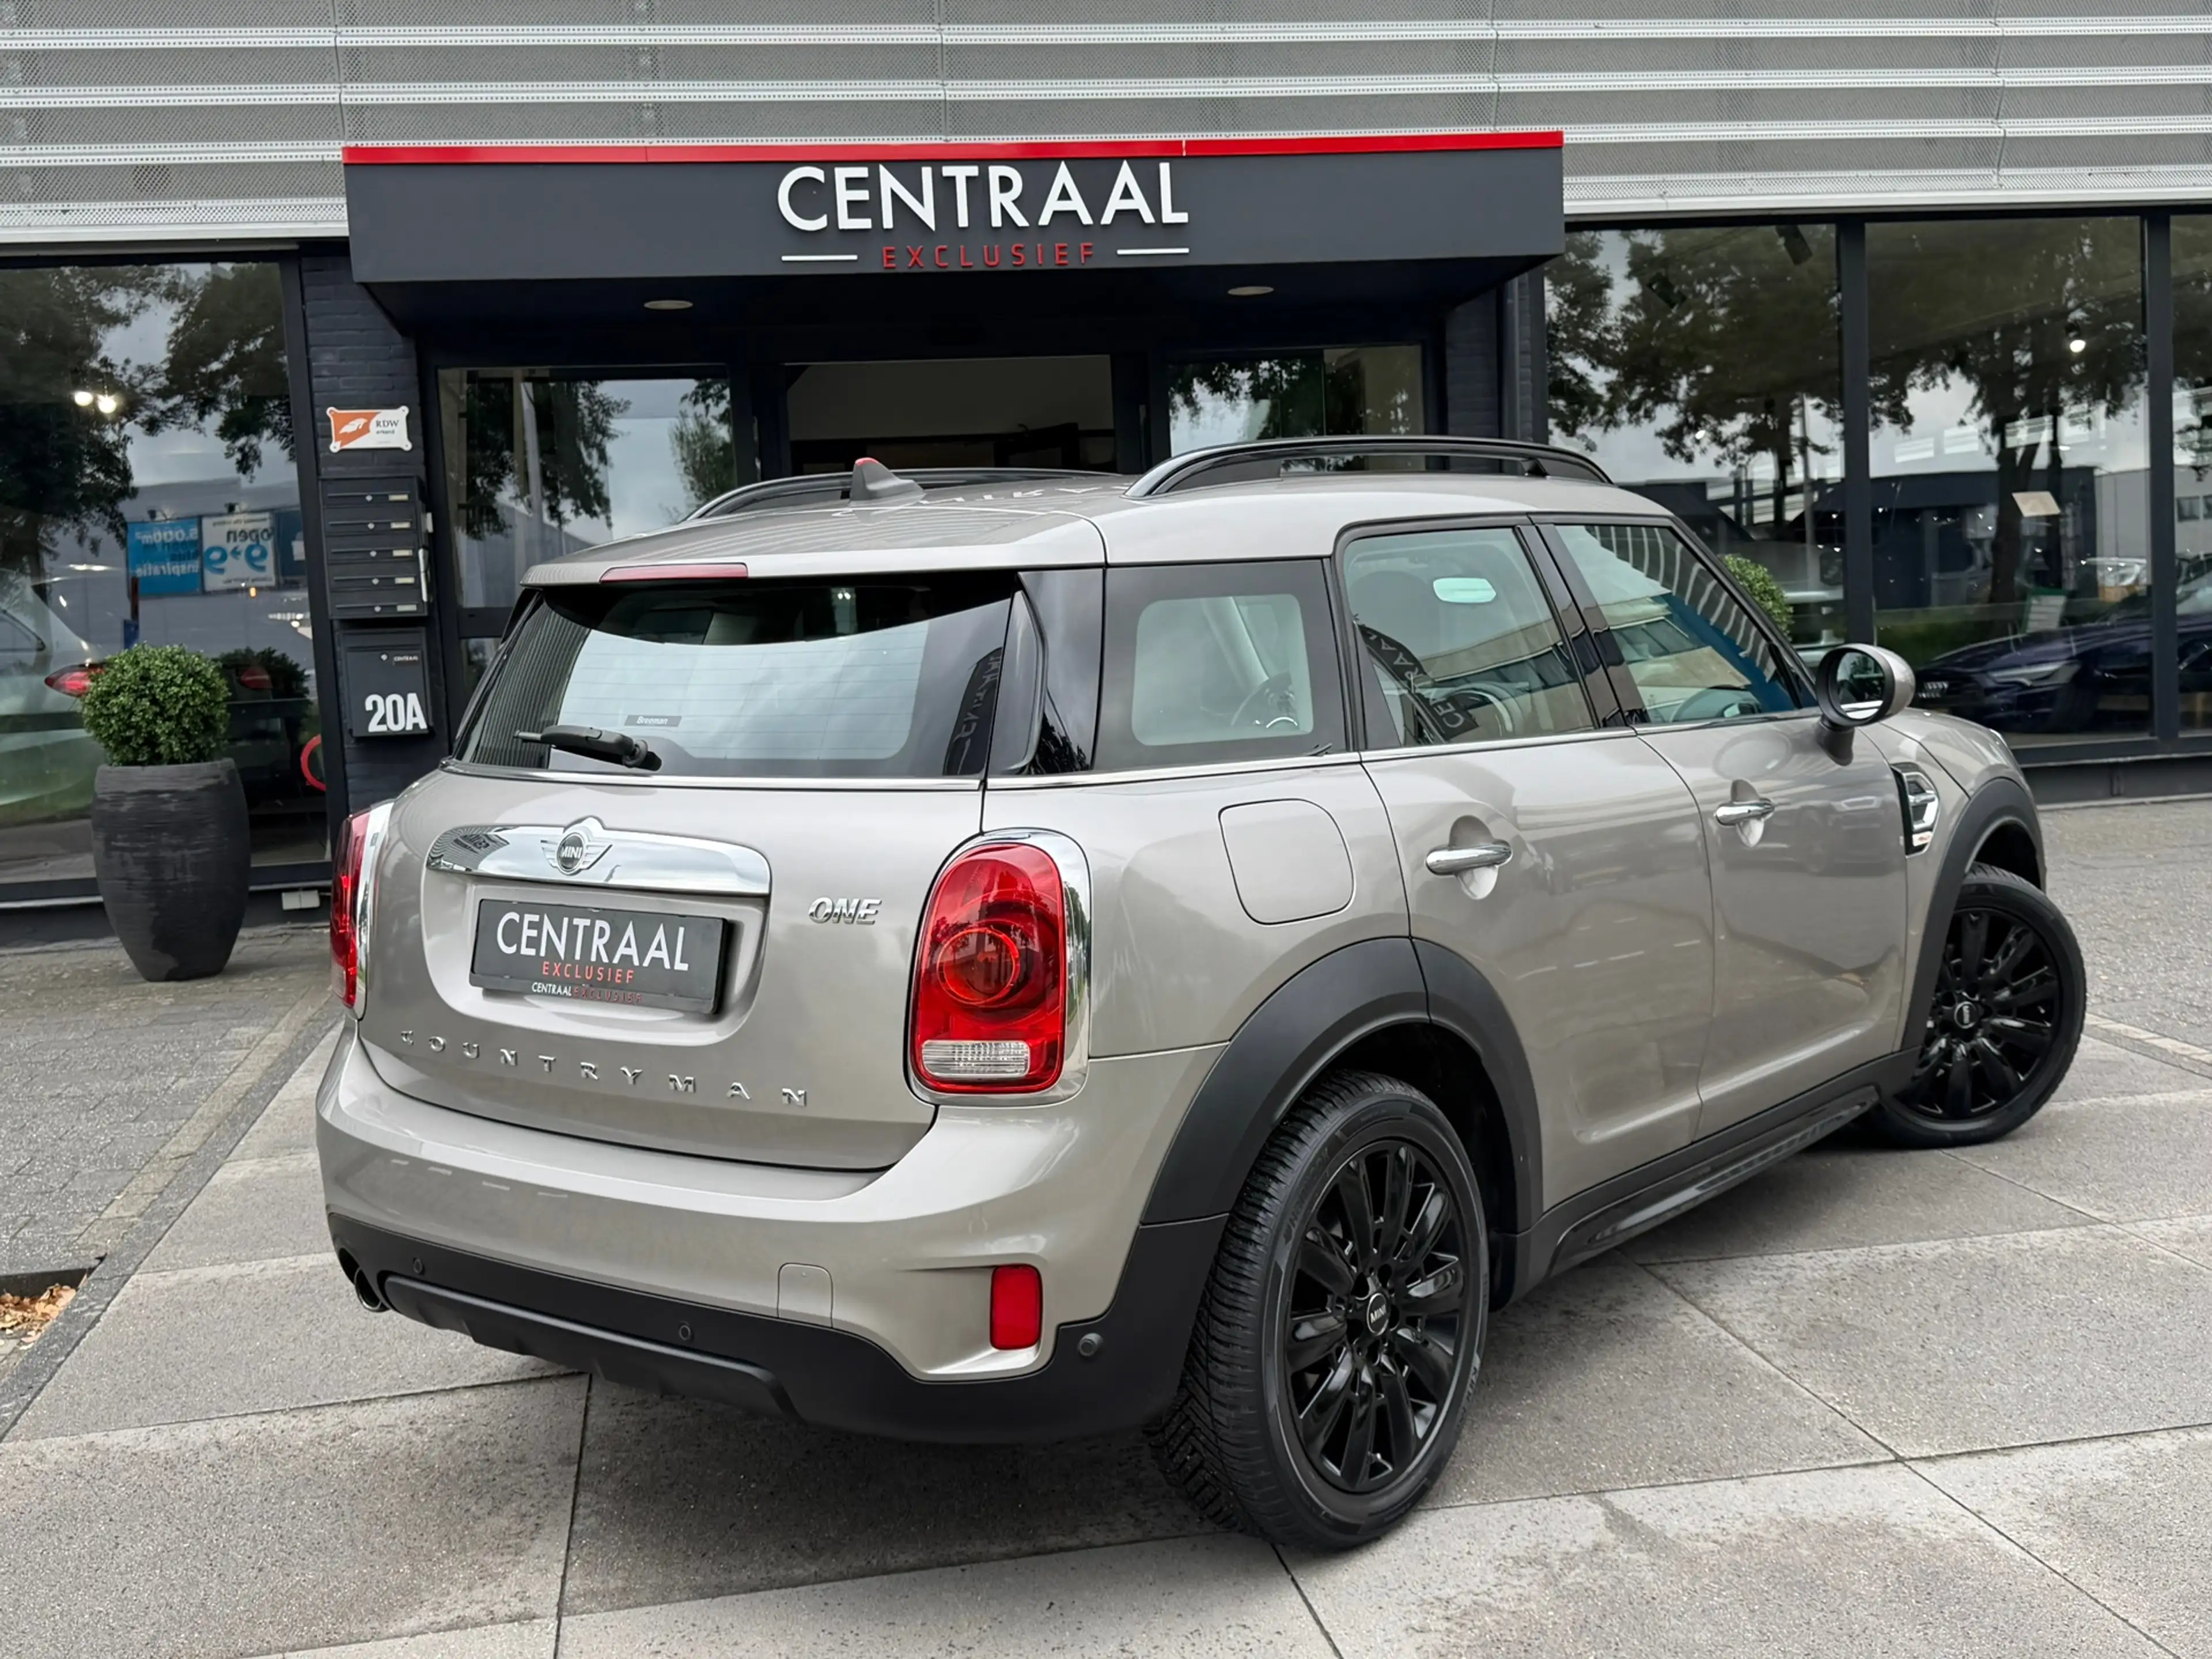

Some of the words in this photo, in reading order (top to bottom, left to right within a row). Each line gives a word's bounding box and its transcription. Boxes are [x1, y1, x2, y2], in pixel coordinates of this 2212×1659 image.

[777, 160, 1190, 232] CENTRAAL
[881, 242, 1094, 269] EXCLUSIEF
[376, 419, 399, 427] RDW
[365, 692, 427, 732] 20A
[560, 846, 583, 859] MINI
[808, 897, 882, 925] ONE
[496, 911, 690, 971] CENTRAAL
[541, 961, 634, 984] EXCLUSIEF
[402, 1030, 806, 1107] COUNTRYMAN
[1370, 1304, 1387, 1324] MINI
